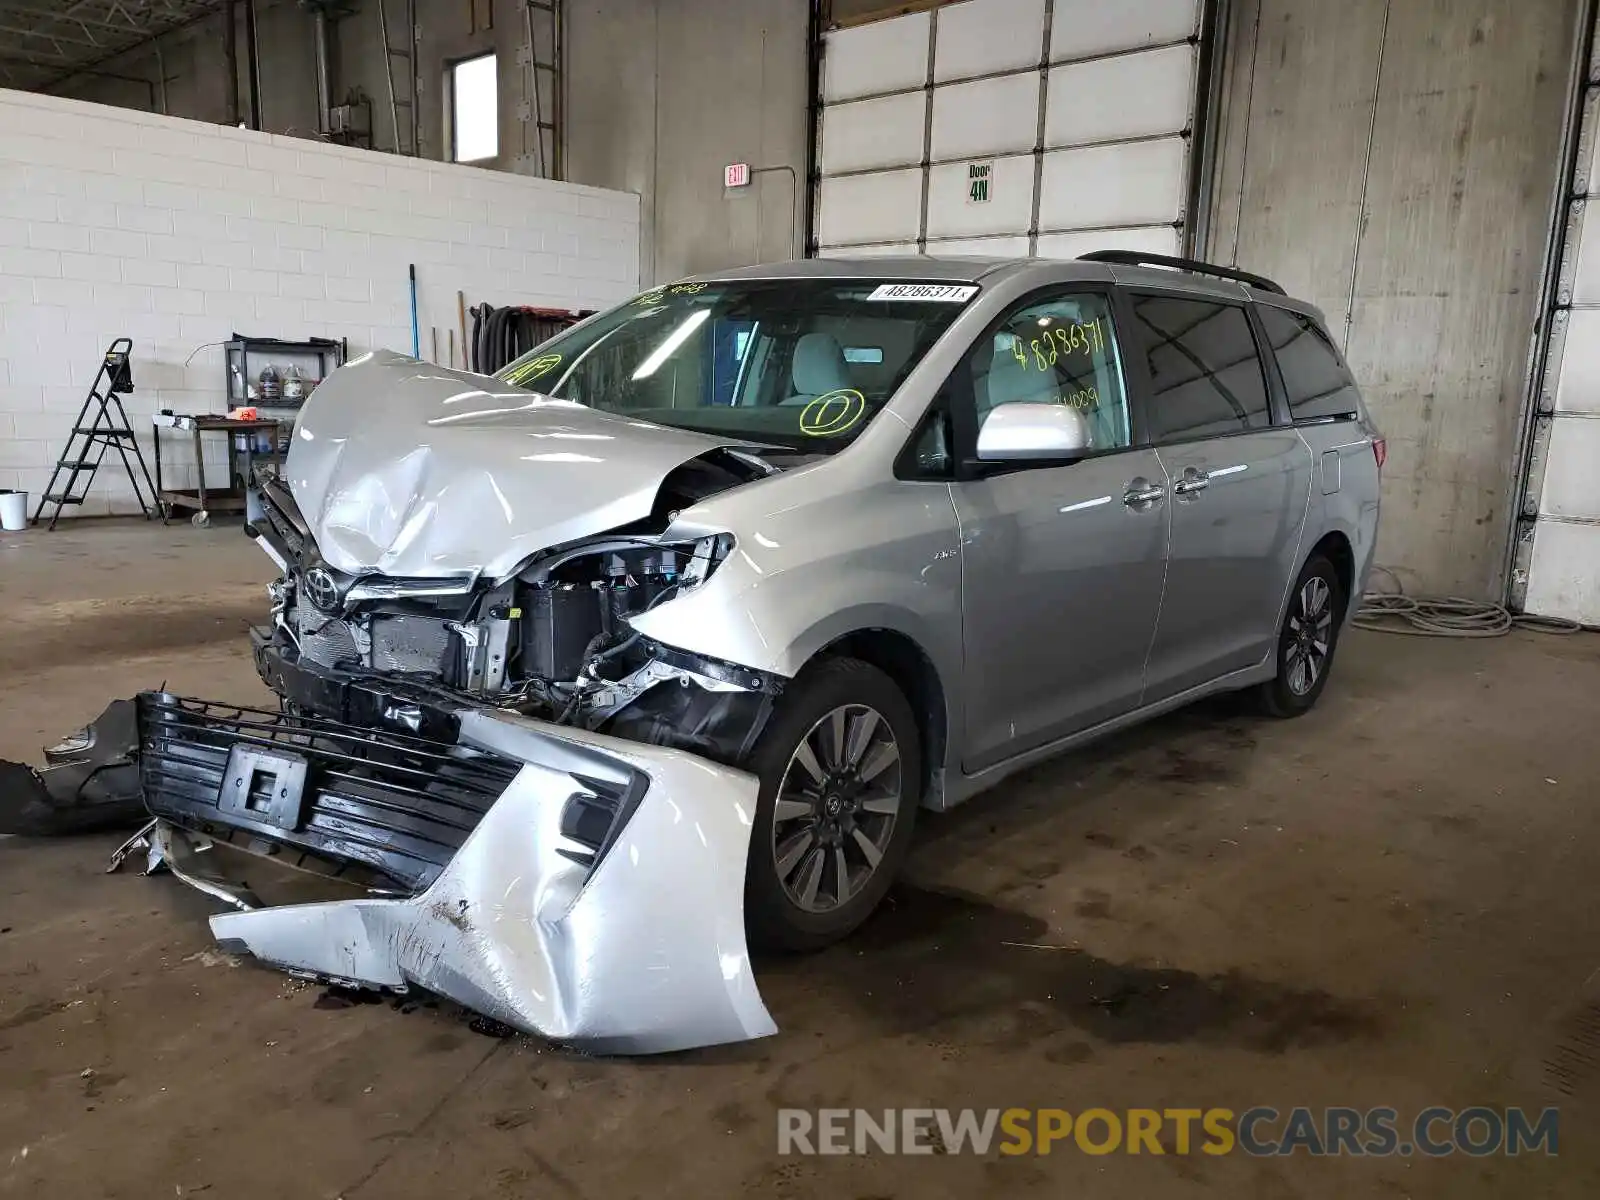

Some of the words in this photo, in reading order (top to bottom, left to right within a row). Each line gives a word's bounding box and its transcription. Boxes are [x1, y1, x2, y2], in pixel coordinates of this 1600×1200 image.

[728, 166, 744, 184] EXIT
[970, 165, 990, 178] Door
[970, 180, 988, 201] 4N
[1011, 317, 1104, 371] 48286371
